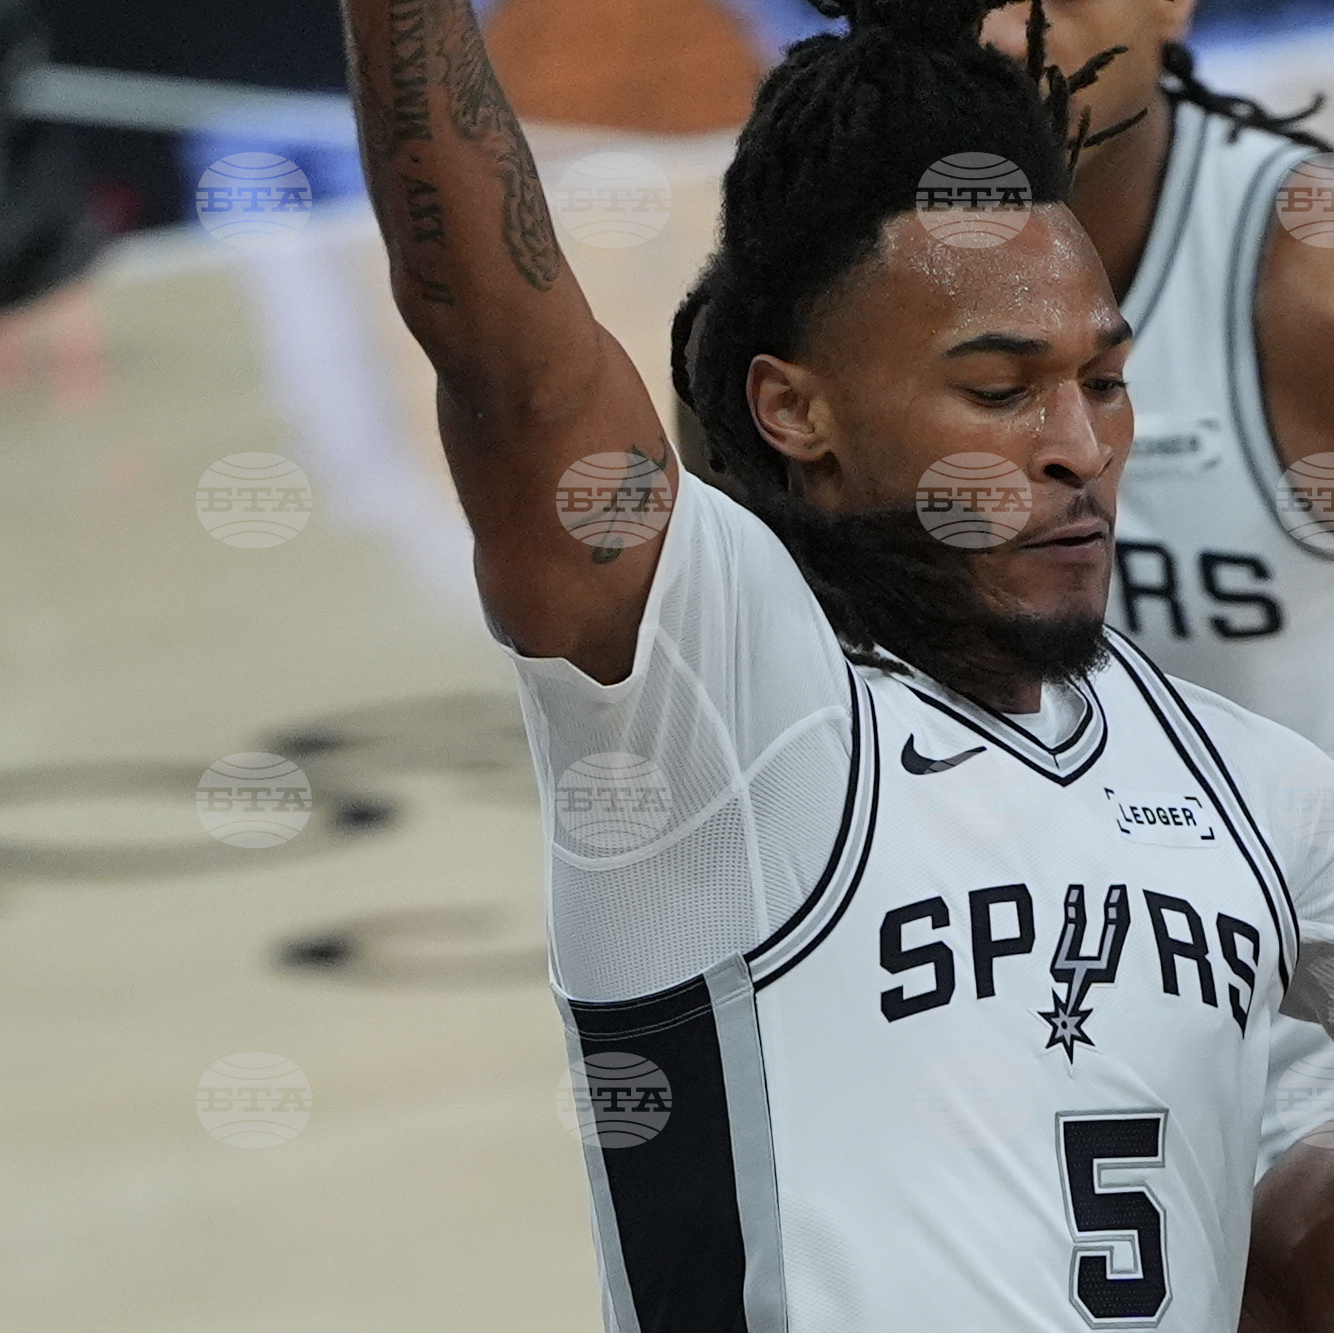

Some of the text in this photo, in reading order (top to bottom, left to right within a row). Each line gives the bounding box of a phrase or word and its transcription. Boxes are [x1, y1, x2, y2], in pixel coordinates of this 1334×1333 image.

[1119, 803, 1197, 826] LEDGER
[880, 882, 1260, 1060] SPURS
[1055, 1108, 1173, 1330] 5
